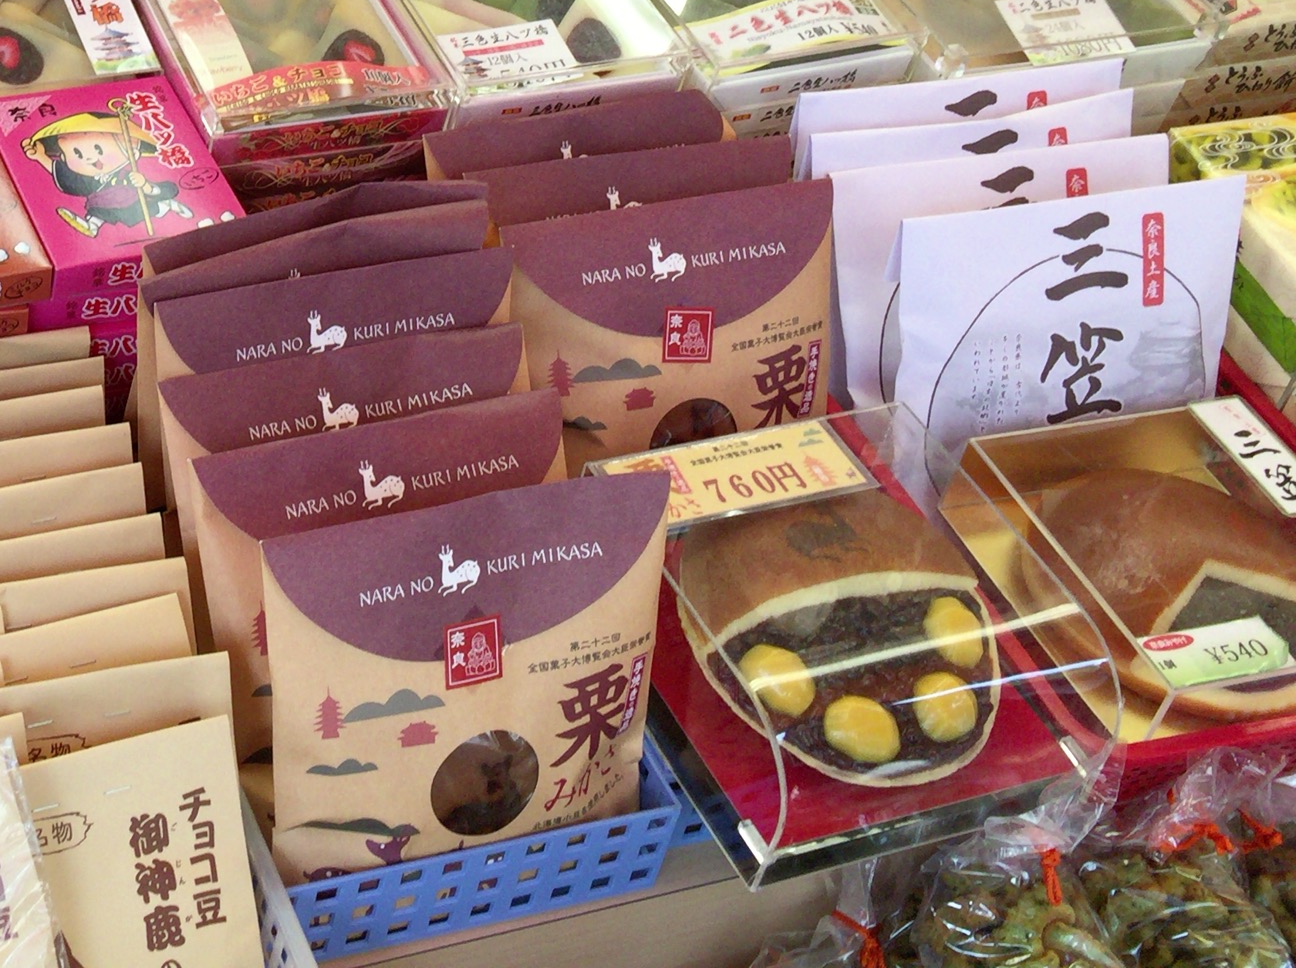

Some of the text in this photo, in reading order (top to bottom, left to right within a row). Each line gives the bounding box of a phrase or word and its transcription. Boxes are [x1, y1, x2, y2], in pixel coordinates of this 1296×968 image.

[582, 241, 786, 285] NARA NO KURI MIKASA
[1144, 217, 1163, 300] 奈良土産
[236, 312, 455, 362] NARA NO KURI MIKASA
[1040, 211, 1128, 424] 三笠
[249, 382, 473, 441] NARA NO KURI MIKASA
[752, 343, 806, 429] 栗
[285, 454, 520, 520] NARA NO KURI MIKASA
[703, 461, 807, 503] 760円
[359, 541, 603, 607] NARA NO KURI MIKASA
[569, 632, 621, 652] 第二十二回
[1205, 639, 1268, 665] ¥540
[549, 663, 629, 768] 栗
[179, 787, 228, 930] チョコ豆
